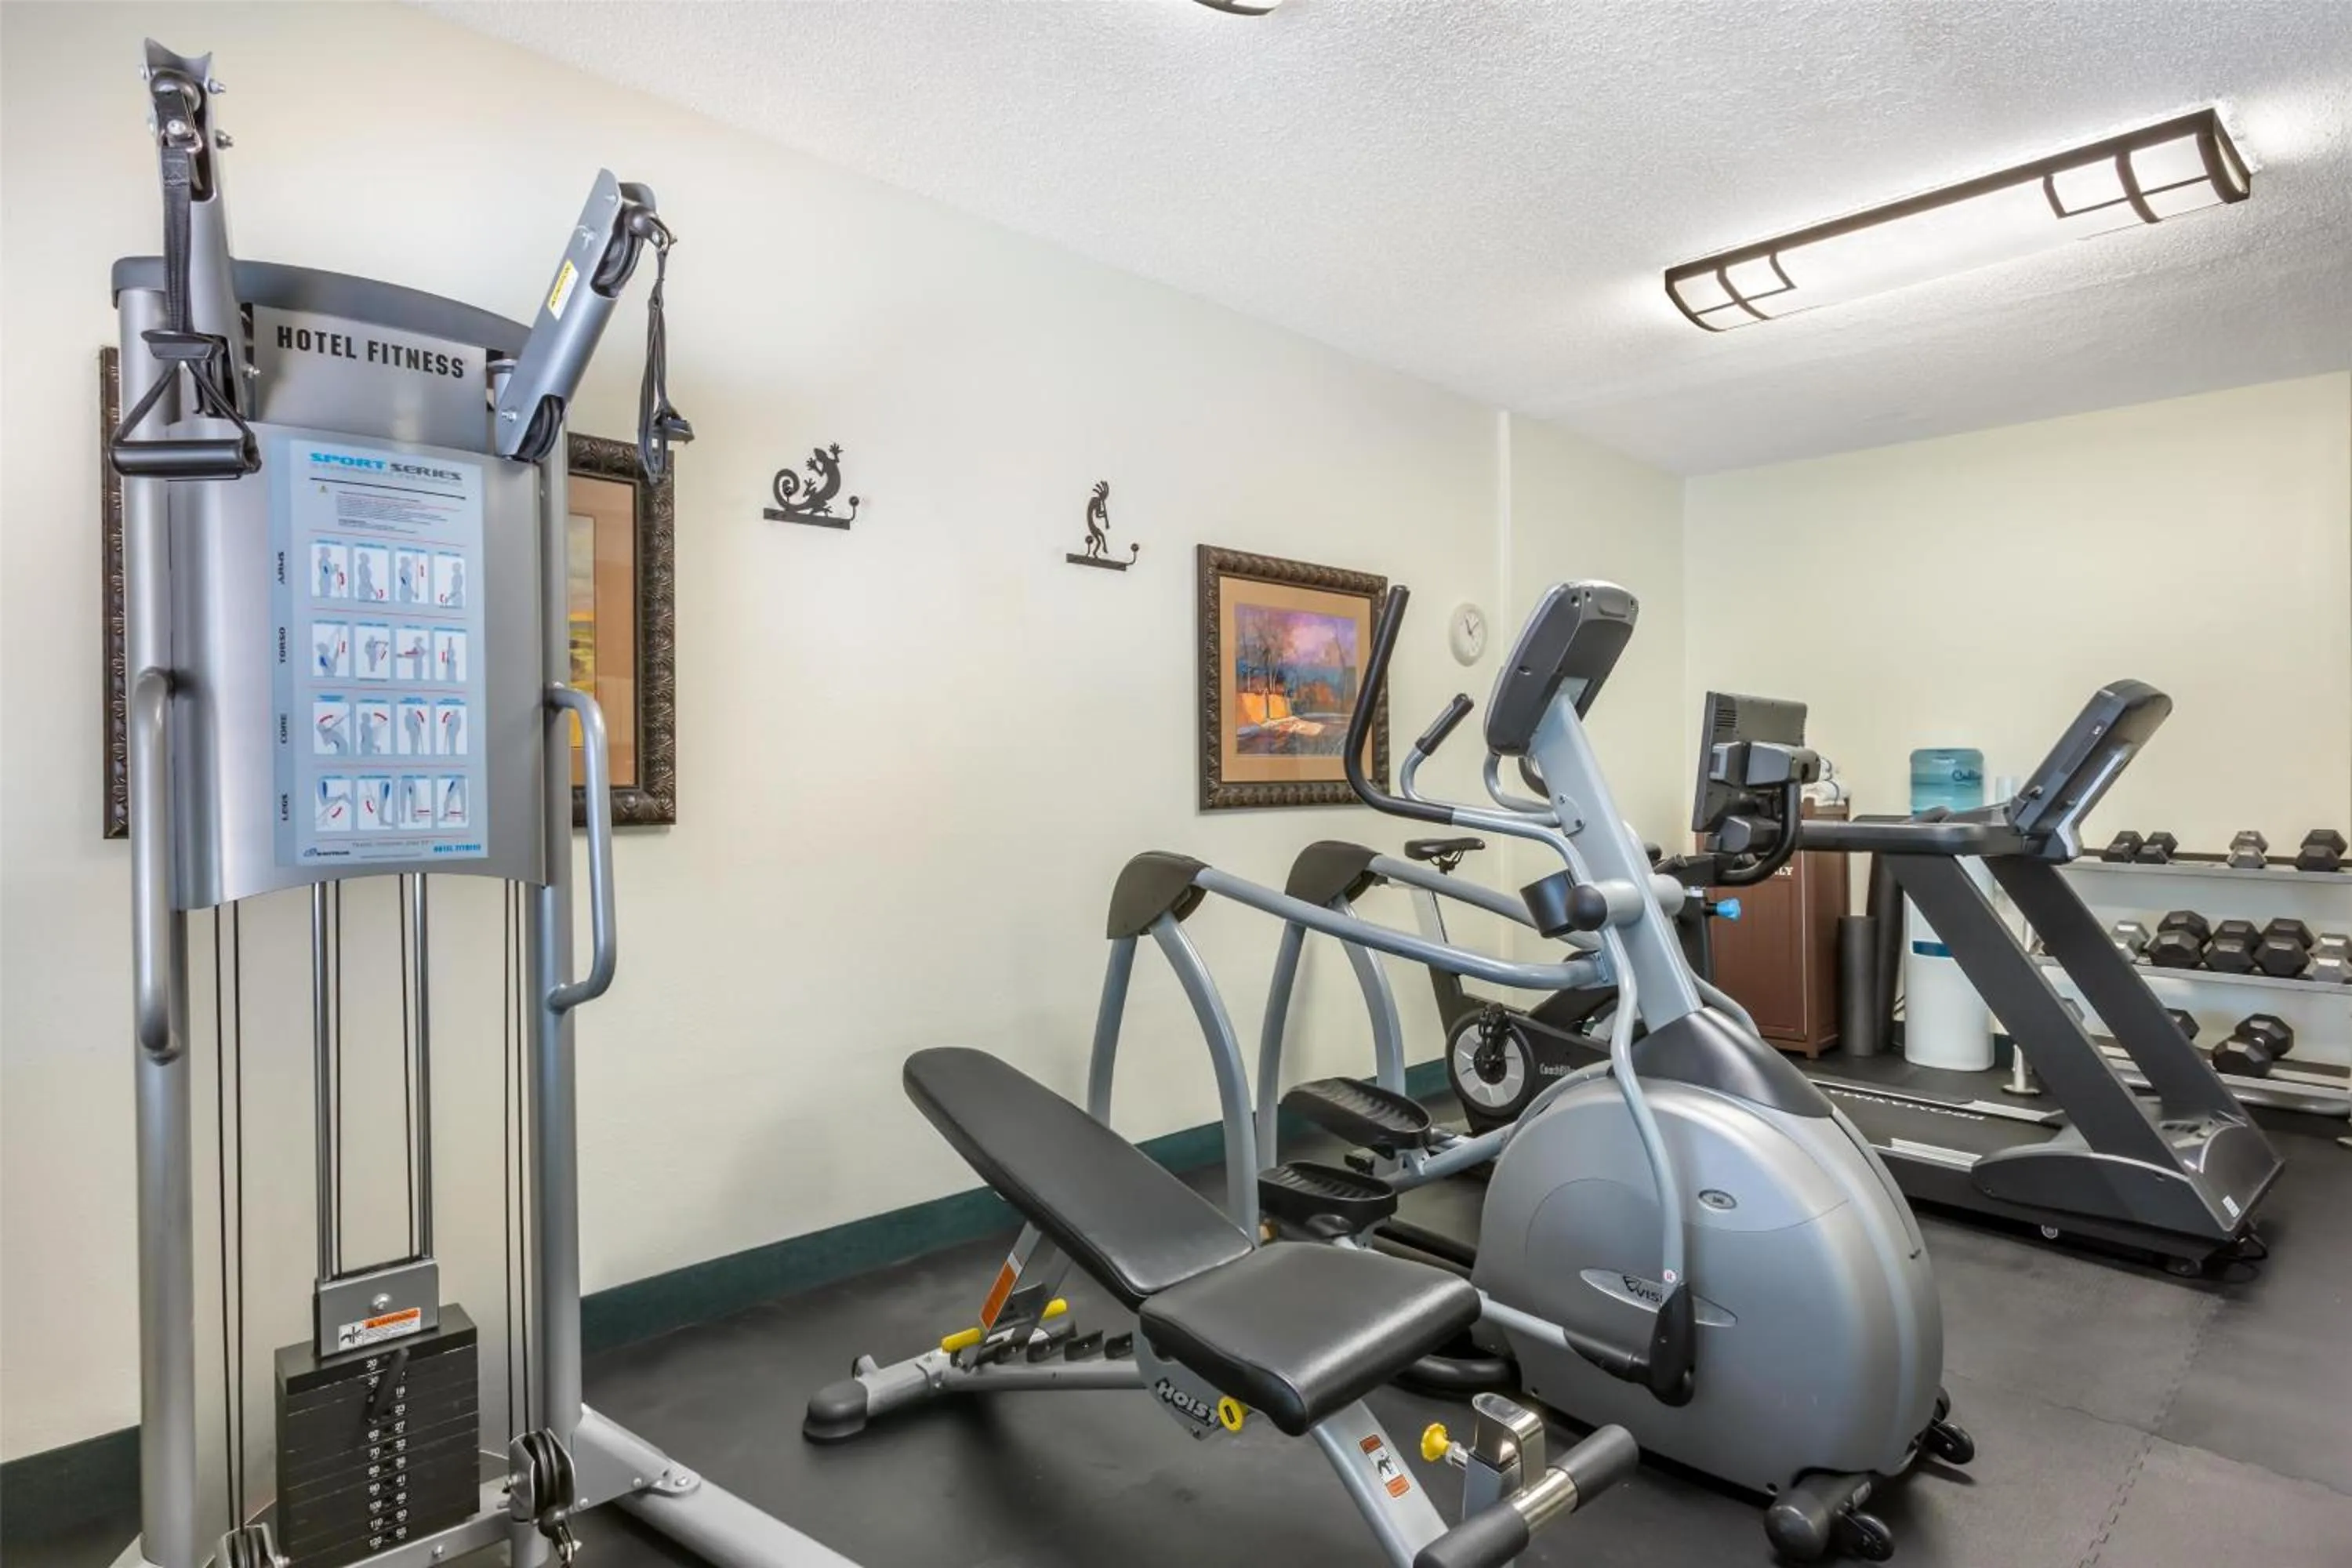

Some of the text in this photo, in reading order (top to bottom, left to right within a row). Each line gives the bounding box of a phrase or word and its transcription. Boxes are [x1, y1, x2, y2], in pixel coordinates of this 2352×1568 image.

[278, 325, 464, 379] HOTEL FITNESS
[310, 452, 462, 481] SPORT SERIES
[1774, 866, 1794, 876] LY
[1155, 1377, 1218, 1425] HOIST
